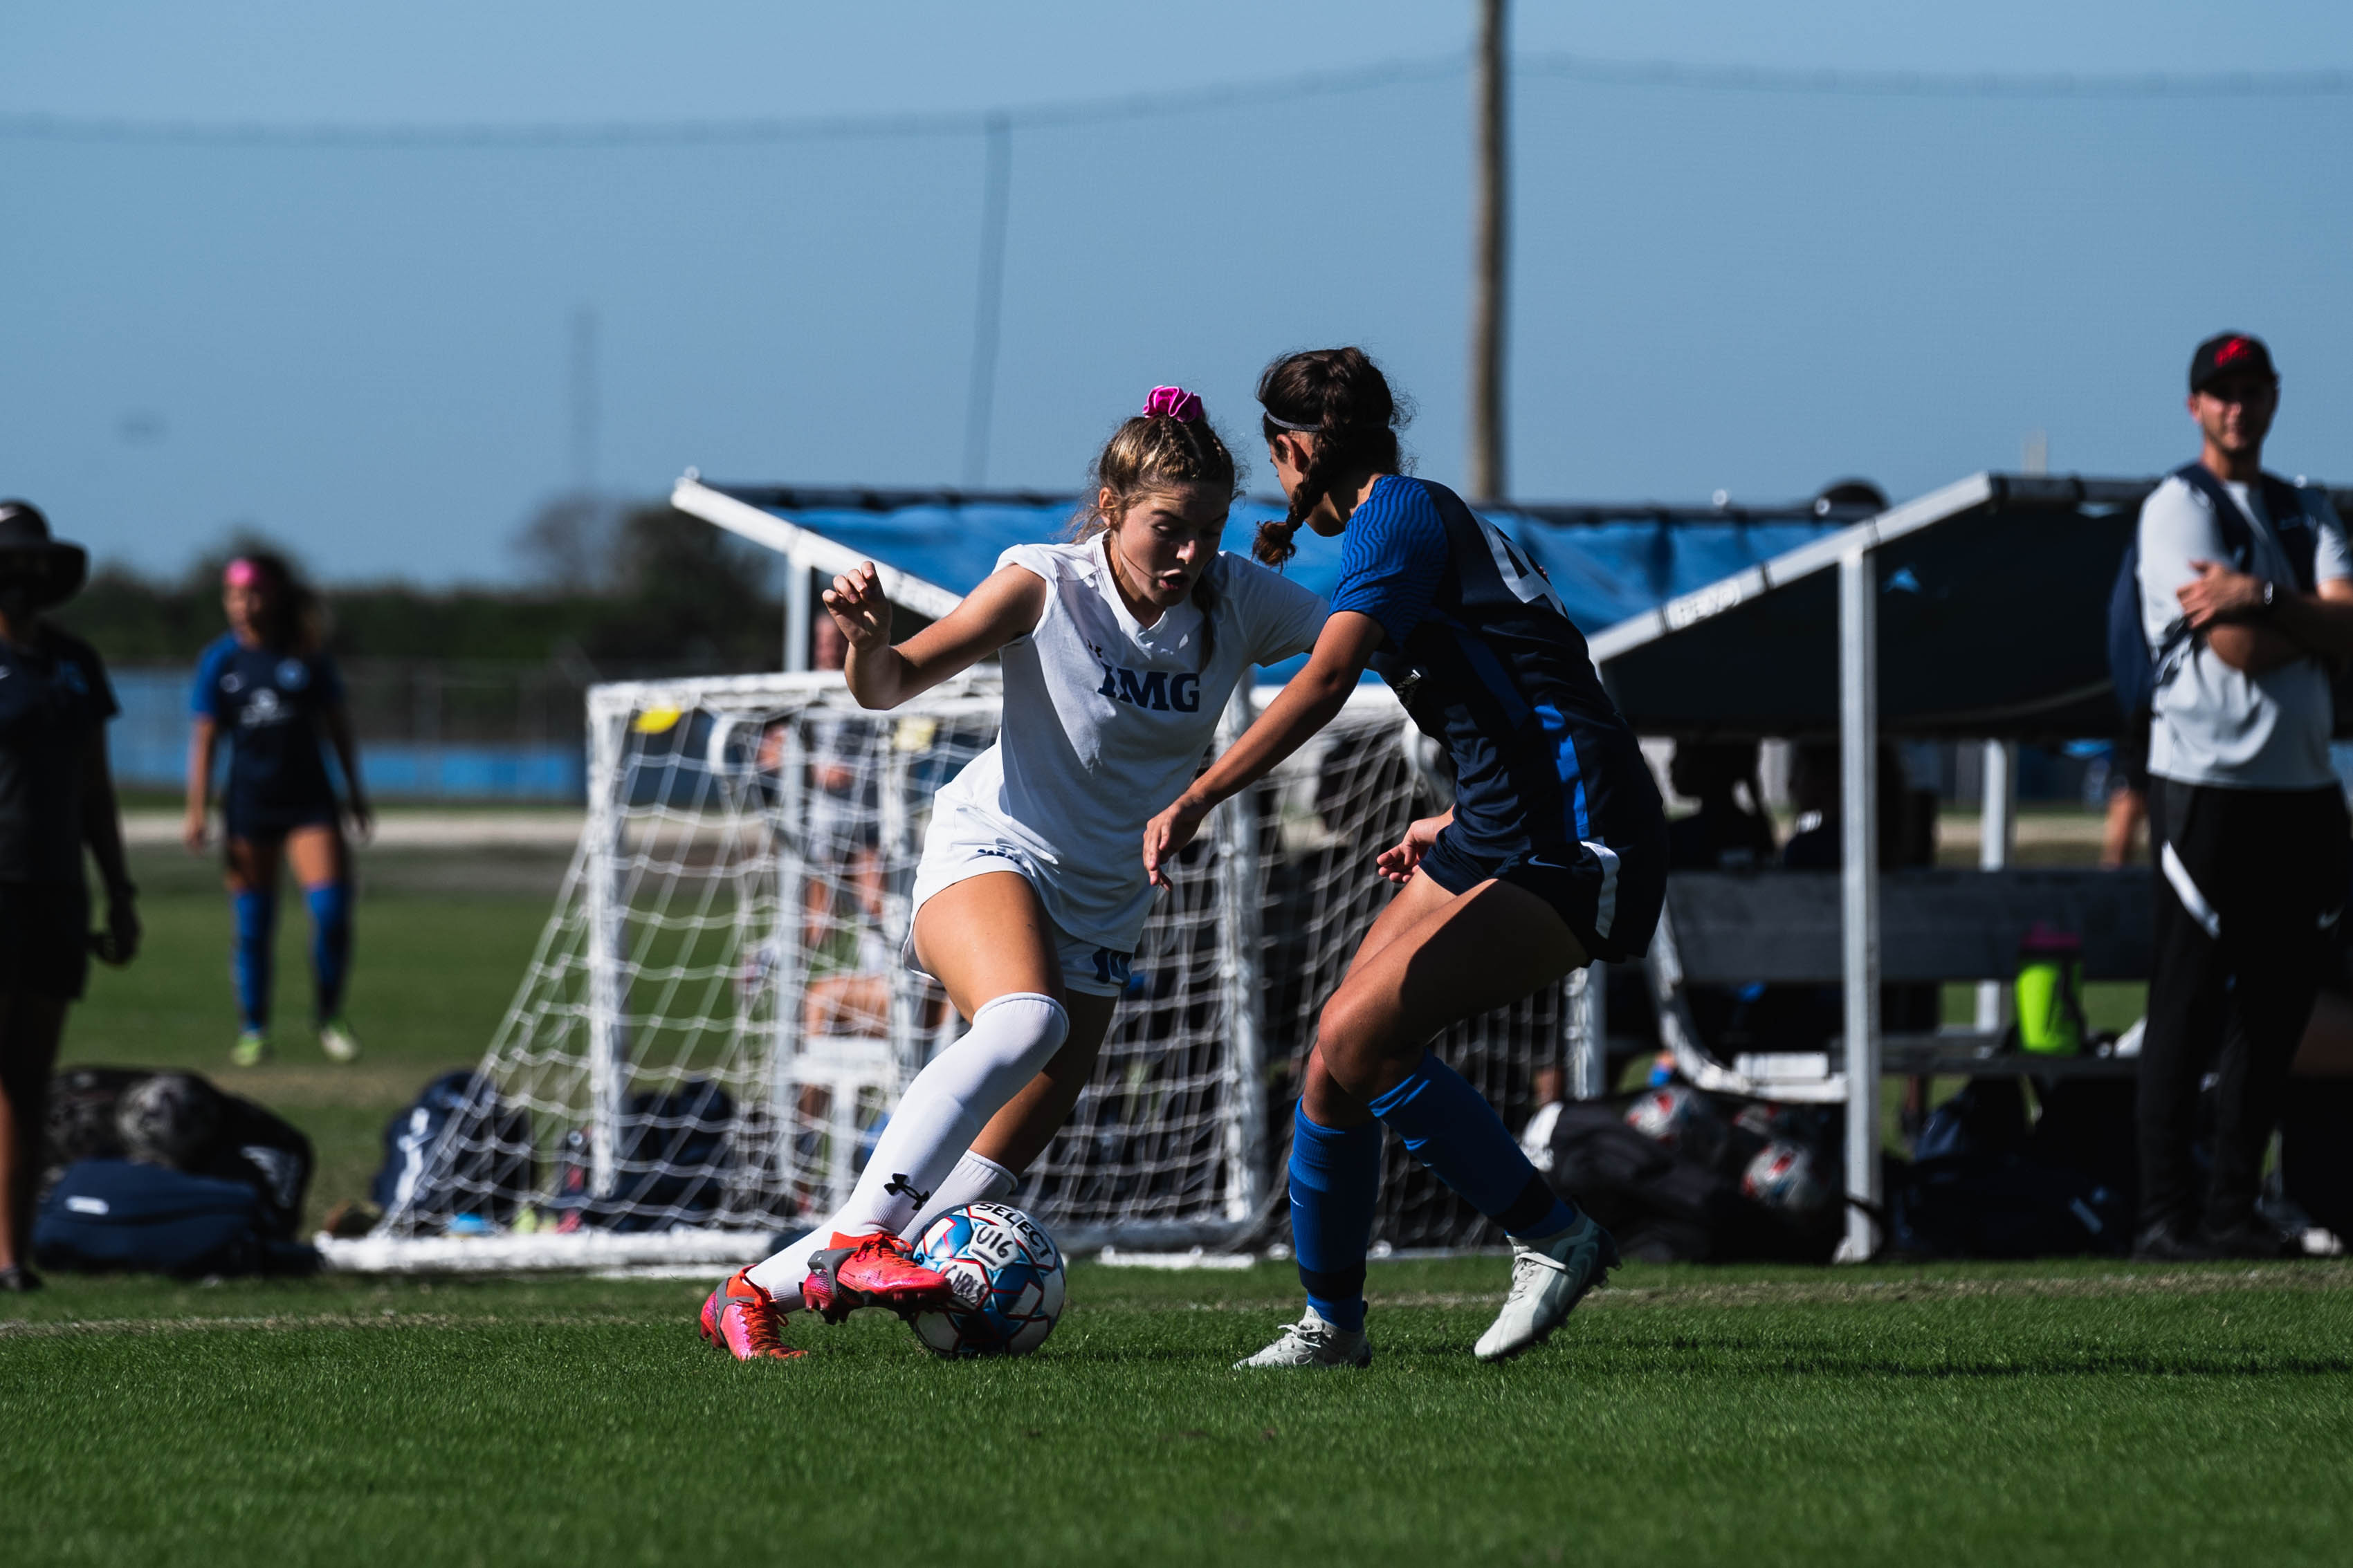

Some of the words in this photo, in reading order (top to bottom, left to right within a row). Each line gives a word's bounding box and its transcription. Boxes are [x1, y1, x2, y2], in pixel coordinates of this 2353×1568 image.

[1097, 662, 1200, 713] IMG
[976, 1203, 1052, 1257] SELECT
[976, 1226, 1013, 1258] U16
